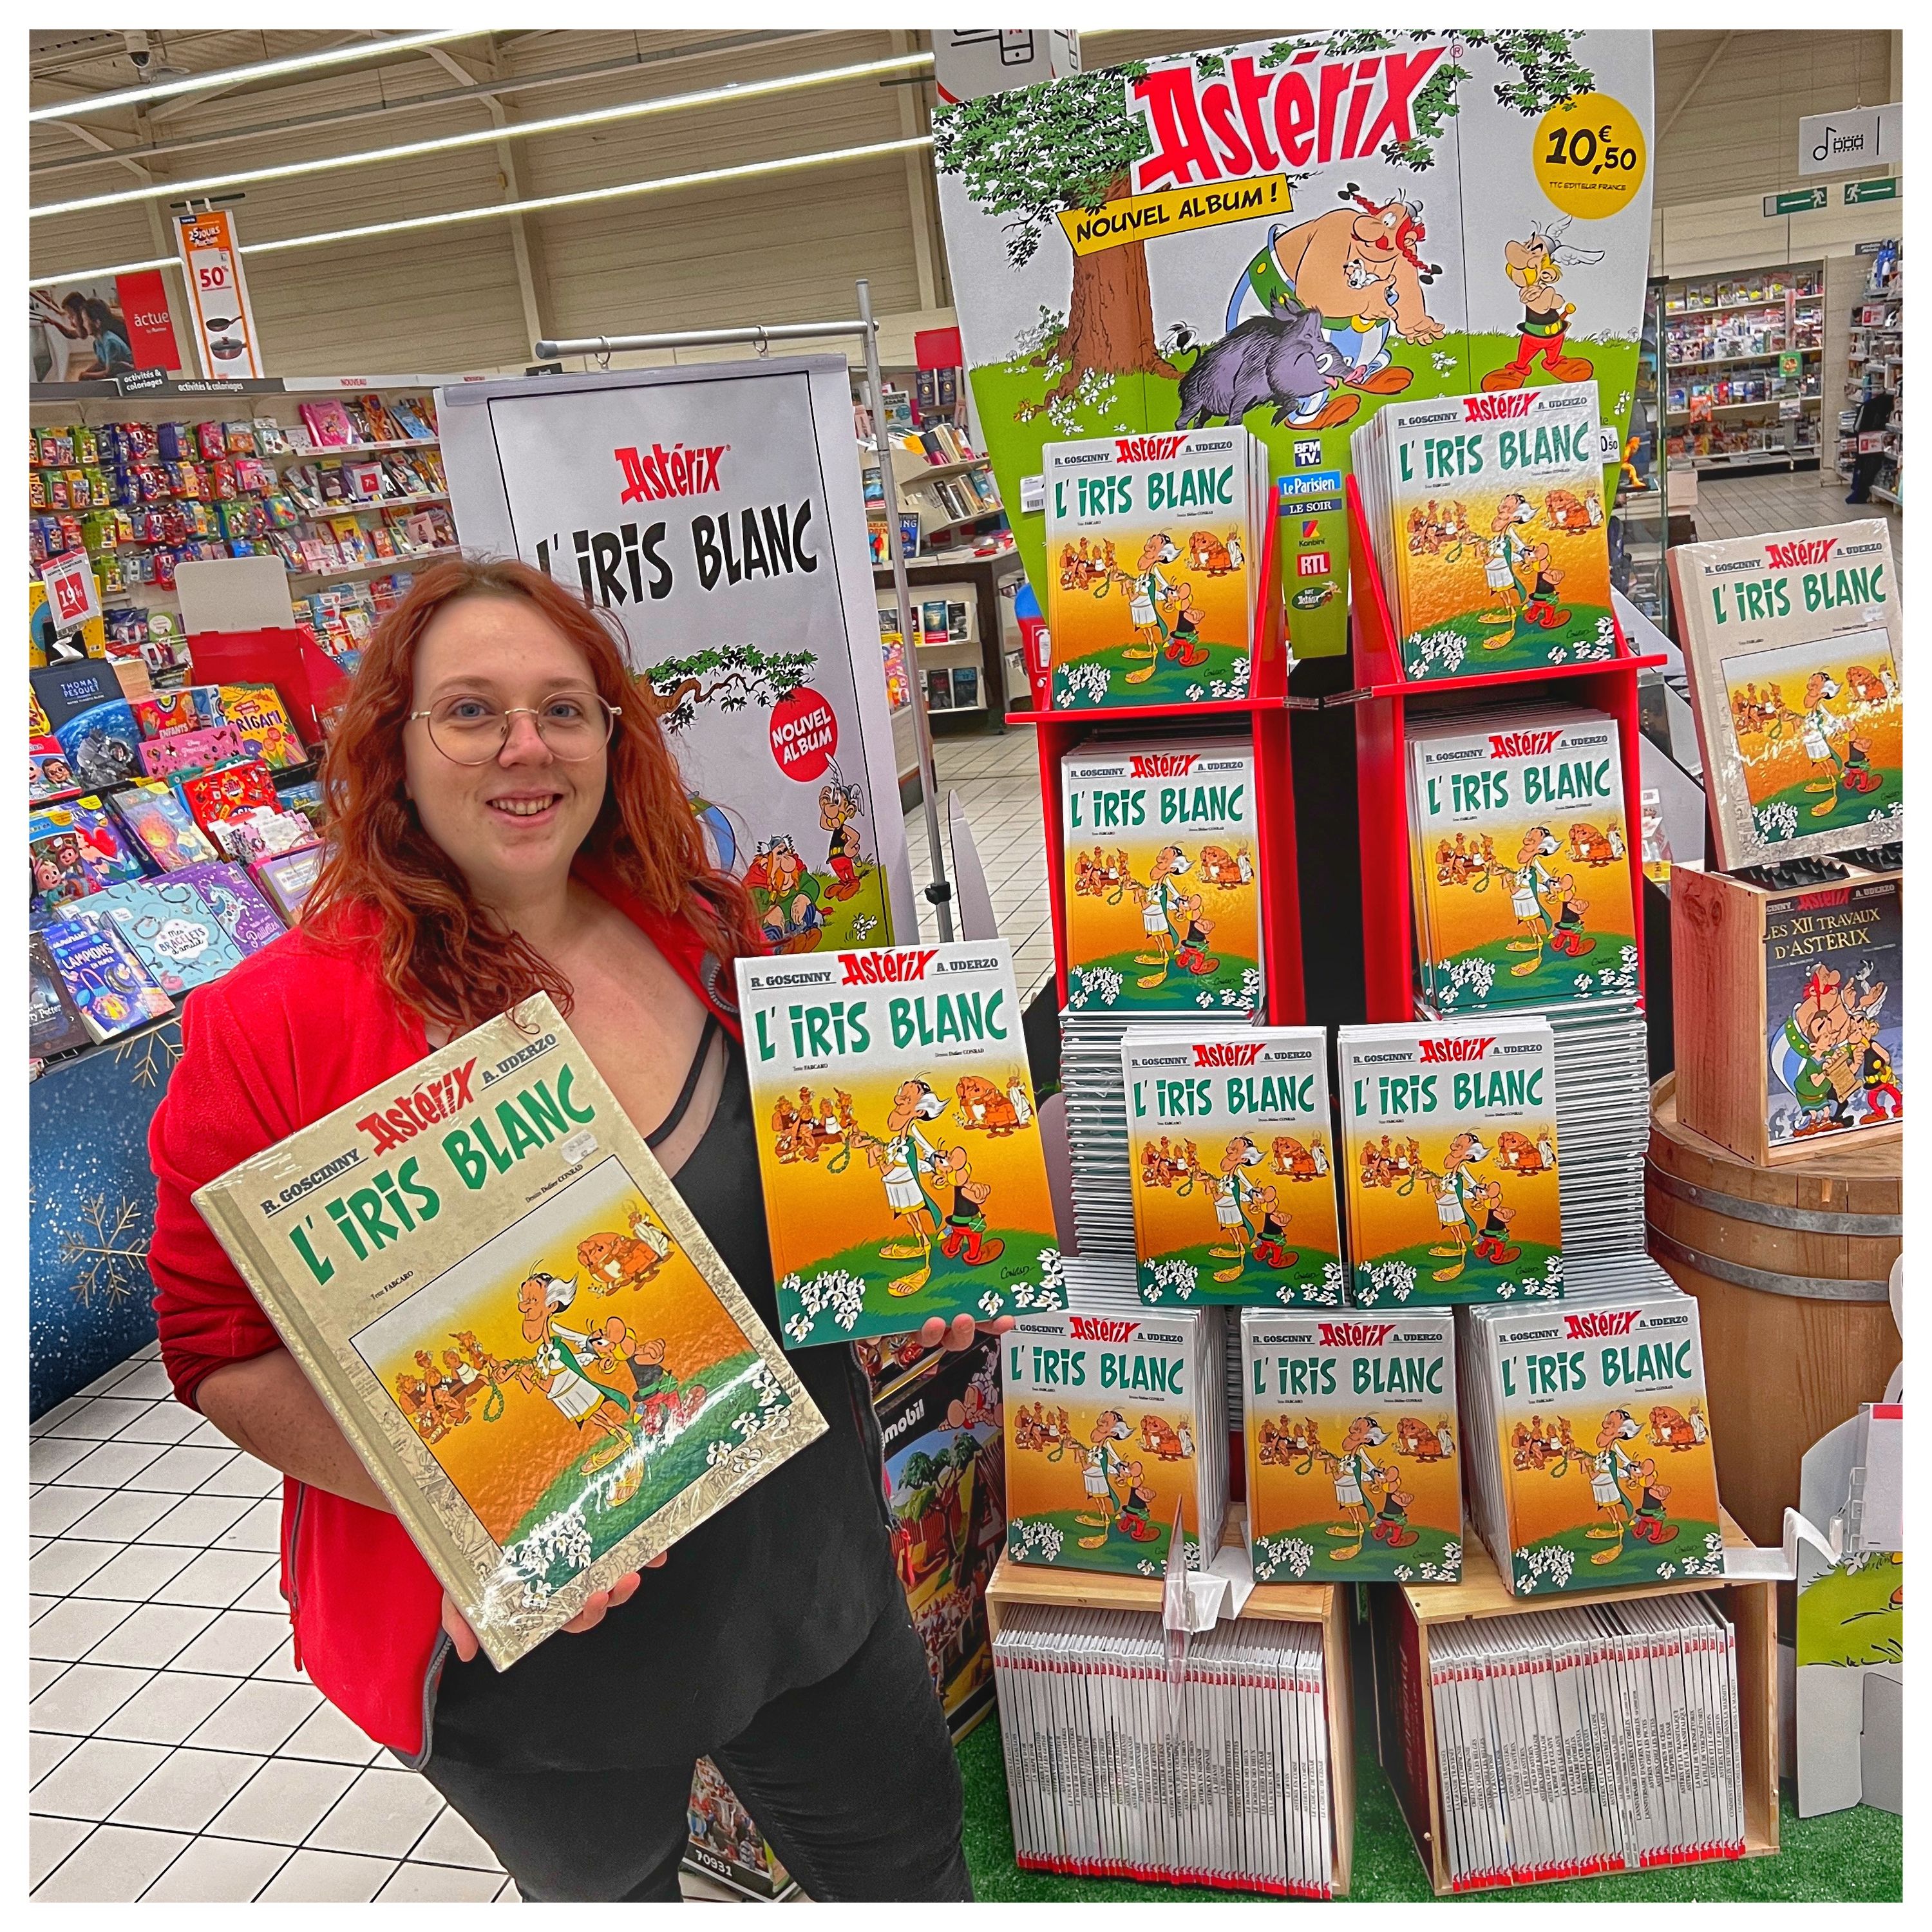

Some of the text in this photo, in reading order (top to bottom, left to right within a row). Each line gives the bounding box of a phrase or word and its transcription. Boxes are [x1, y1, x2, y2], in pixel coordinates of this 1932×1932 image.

[1076, 204, 1170, 243] NOUVEL
[1180, 187, 1264, 220] ALBUM
[124, 372, 151, 383] activités
[126, 379, 163, 392] coloriages
[1408, 412, 1457, 425] GOSCINNY
[1549, 397, 1587, 408] UDERZO
[1065, 453, 1110, 464] GOSCINNY
[1196, 440, 1233, 451] UDERZO
[1294, 440, 1320, 453] BFM
[1499, 421, 1589, 470] BLANC
[1148, 465, 1233, 511] BLANC
[1289, 501, 1332, 513] LE SOIR
[692, 498, 817, 591] BLANC
[1299, 538, 1325, 547] Konbini
[1300, 554, 1328, 574] RTL
[1715, 559, 1761, 572] GOSCINNY
[1846, 543, 1882, 554] UDERZO
[1803, 564, 1886, 612] BLANC
[61, 678, 98, 690] THOMAS
[63, 685, 100, 697] PESQUET
[159, 724, 189, 739] ENFANTS
[772, 706, 833, 748] NOUVEL
[782, 726, 833, 764] ALBUM
[1436, 749, 1482, 761] GOSCINNY
[1571, 735, 1608, 746] UDERZO
[1080, 768, 1124, 777] GOSCINNY
[1208, 761, 1243, 770] UDERZO
[1524, 758, 1611, 804] BLANC
[1161, 784, 1244, 824] BLANC
[1864, 884, 1895, 896] UDERZO
[1791, 916, 1815, 935] XII
[1817, 908, 1880, 930] TRAVAUX
[160, 927, 205, 951] BRACELETS
[1775, 927, 1871, 960] D'ASTÉRIX
[62, 943, 115, 970] LAMPIONS
[766, 971, 831, 986] GOSCINNY
[950, 958, 998, 971] UDERZO
[39, 1005, 61, 1018] Potter
[889, 989, 1007, 1049] BLANC
[1142, 1057, 1187, 1065] GOSCINNY
[1274, 1051, 1311, 1059] UDERZO
[1364, 1052, 1412, 1063] GOSCINNY
[1504, 1044, 1542, 1054] UDERZO
[1227, 1074, 1314, 1114] BLANC
[1454, 1067, 1543, 1110] BLANC
[279, 1148, 359, 1202] GOSCINNY
[497, 1034, 556, 1074] UDERZO
[442, 1063, 596, 1189] BLANC
[558, 1164, 583, 1182] CONRAD
[1020, 1324, 1064, 1334] GOSCINNY
[1148, 1334, 1183, 1342] UDERZO
[1510, 1329, 1558, 1341] GOSCINNY
[1650, 1315, 1688, 1326] UDERZO
[1101, 1353, 1184, 1394] BLANC
[1353, 1356, 1443, 1394] BLANC
[1602, 1339, 1691, 1387] BLANC
[695, 1849, 733, 1877] 70931
